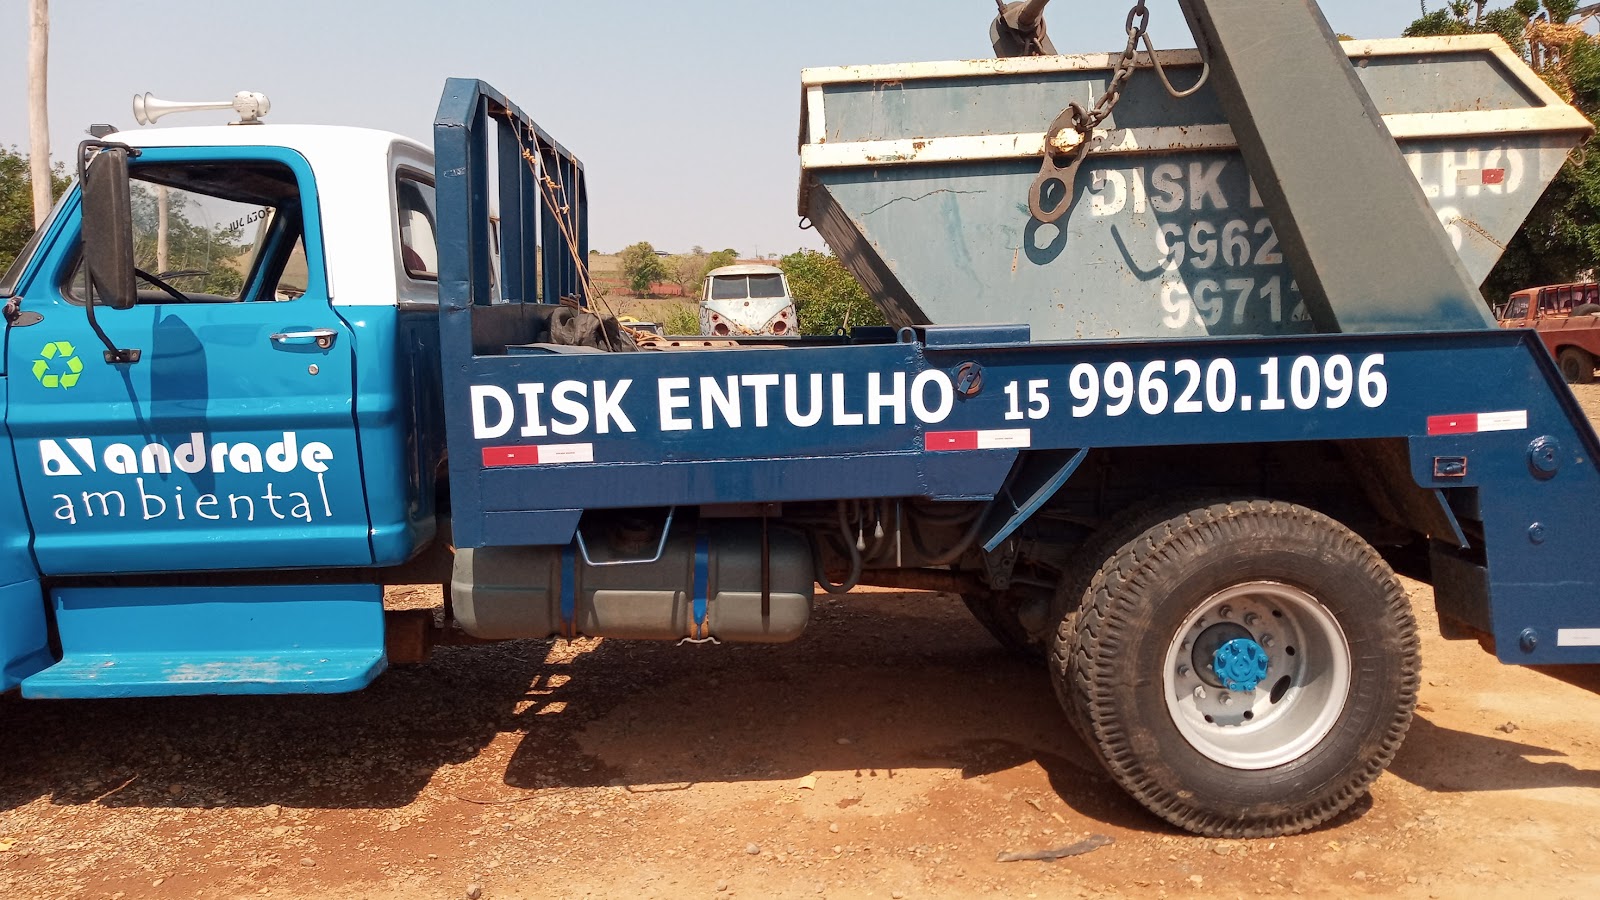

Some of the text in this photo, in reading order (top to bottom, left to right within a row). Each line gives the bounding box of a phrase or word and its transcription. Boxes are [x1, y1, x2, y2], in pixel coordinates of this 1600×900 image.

[1090, 160, 1229, 216] DISK
[469, 353, 1388, 440] DISK ENTULHO 15 99620.1096
[104, 431, 334, 475] andrade
[52, 472, 333, 525] ambiental
